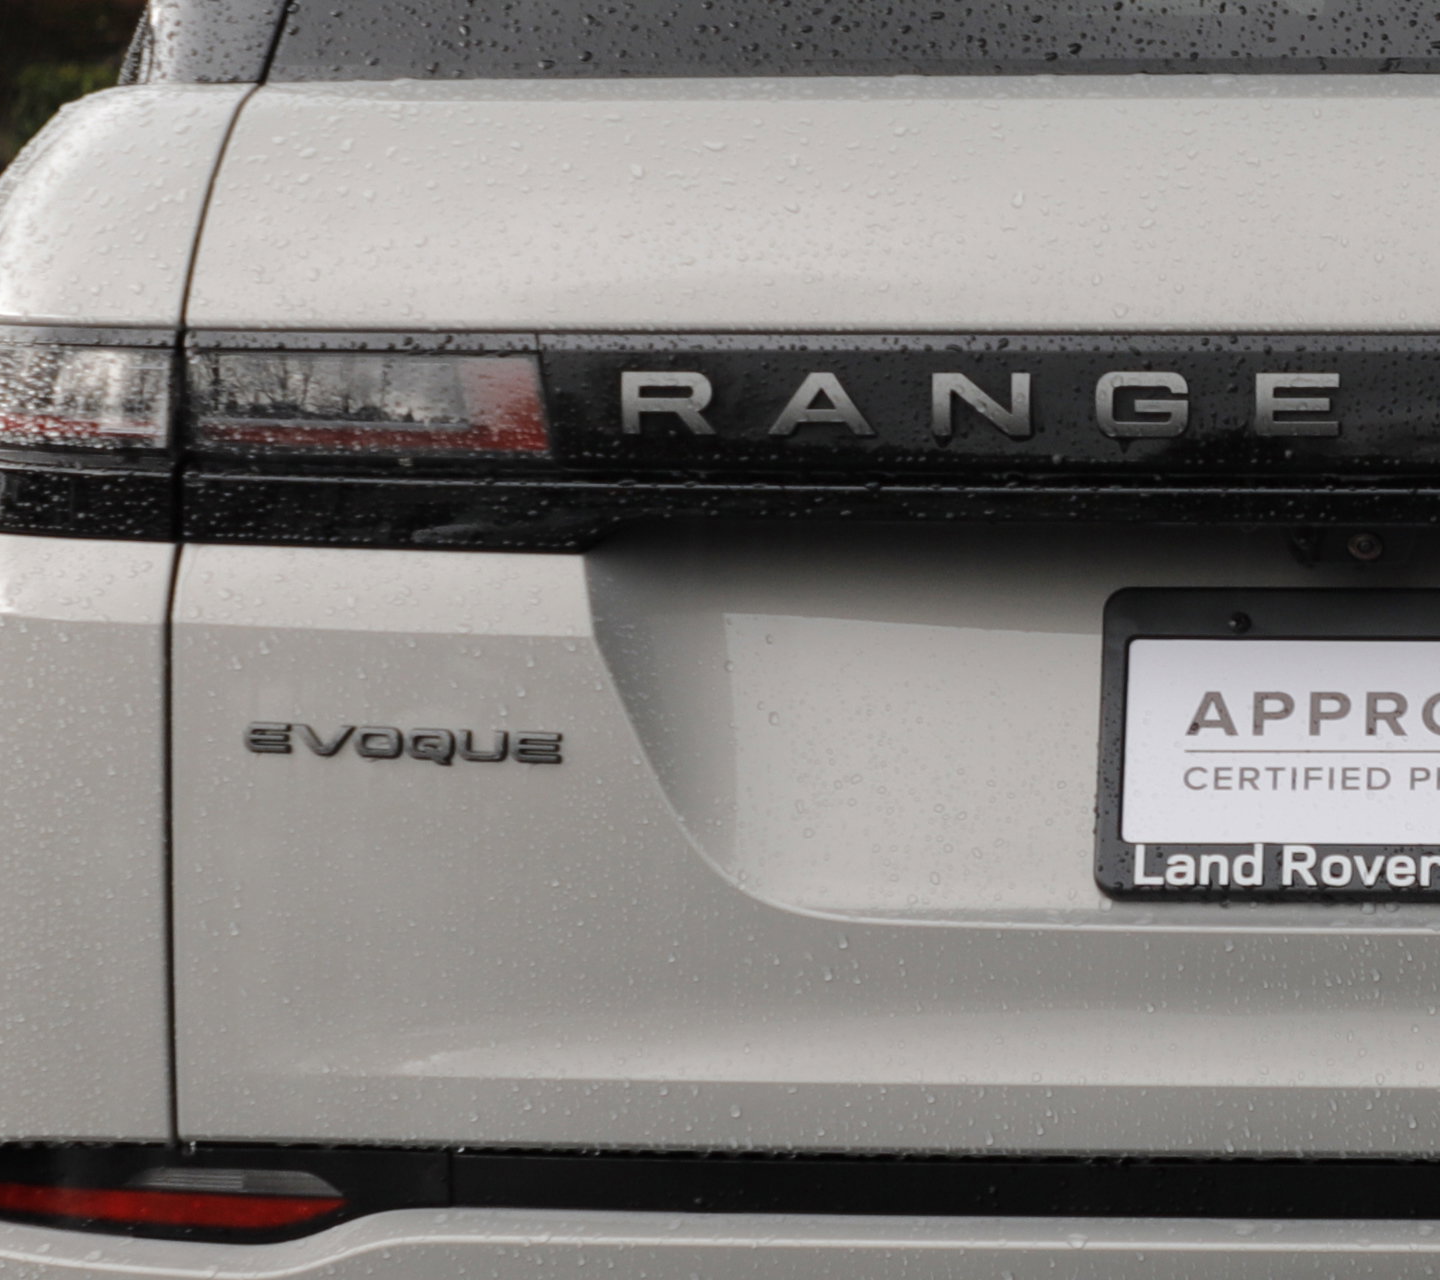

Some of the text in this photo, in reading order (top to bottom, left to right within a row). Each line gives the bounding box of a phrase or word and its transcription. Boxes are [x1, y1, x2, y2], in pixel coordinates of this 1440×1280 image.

[620, 370, 1341, 438] RANGE
[243, 721, 564, 766] EVOQUE
[1182, 765, 1392, 792] CERTIFIED
[1132, 843, 1265, 887] Land
